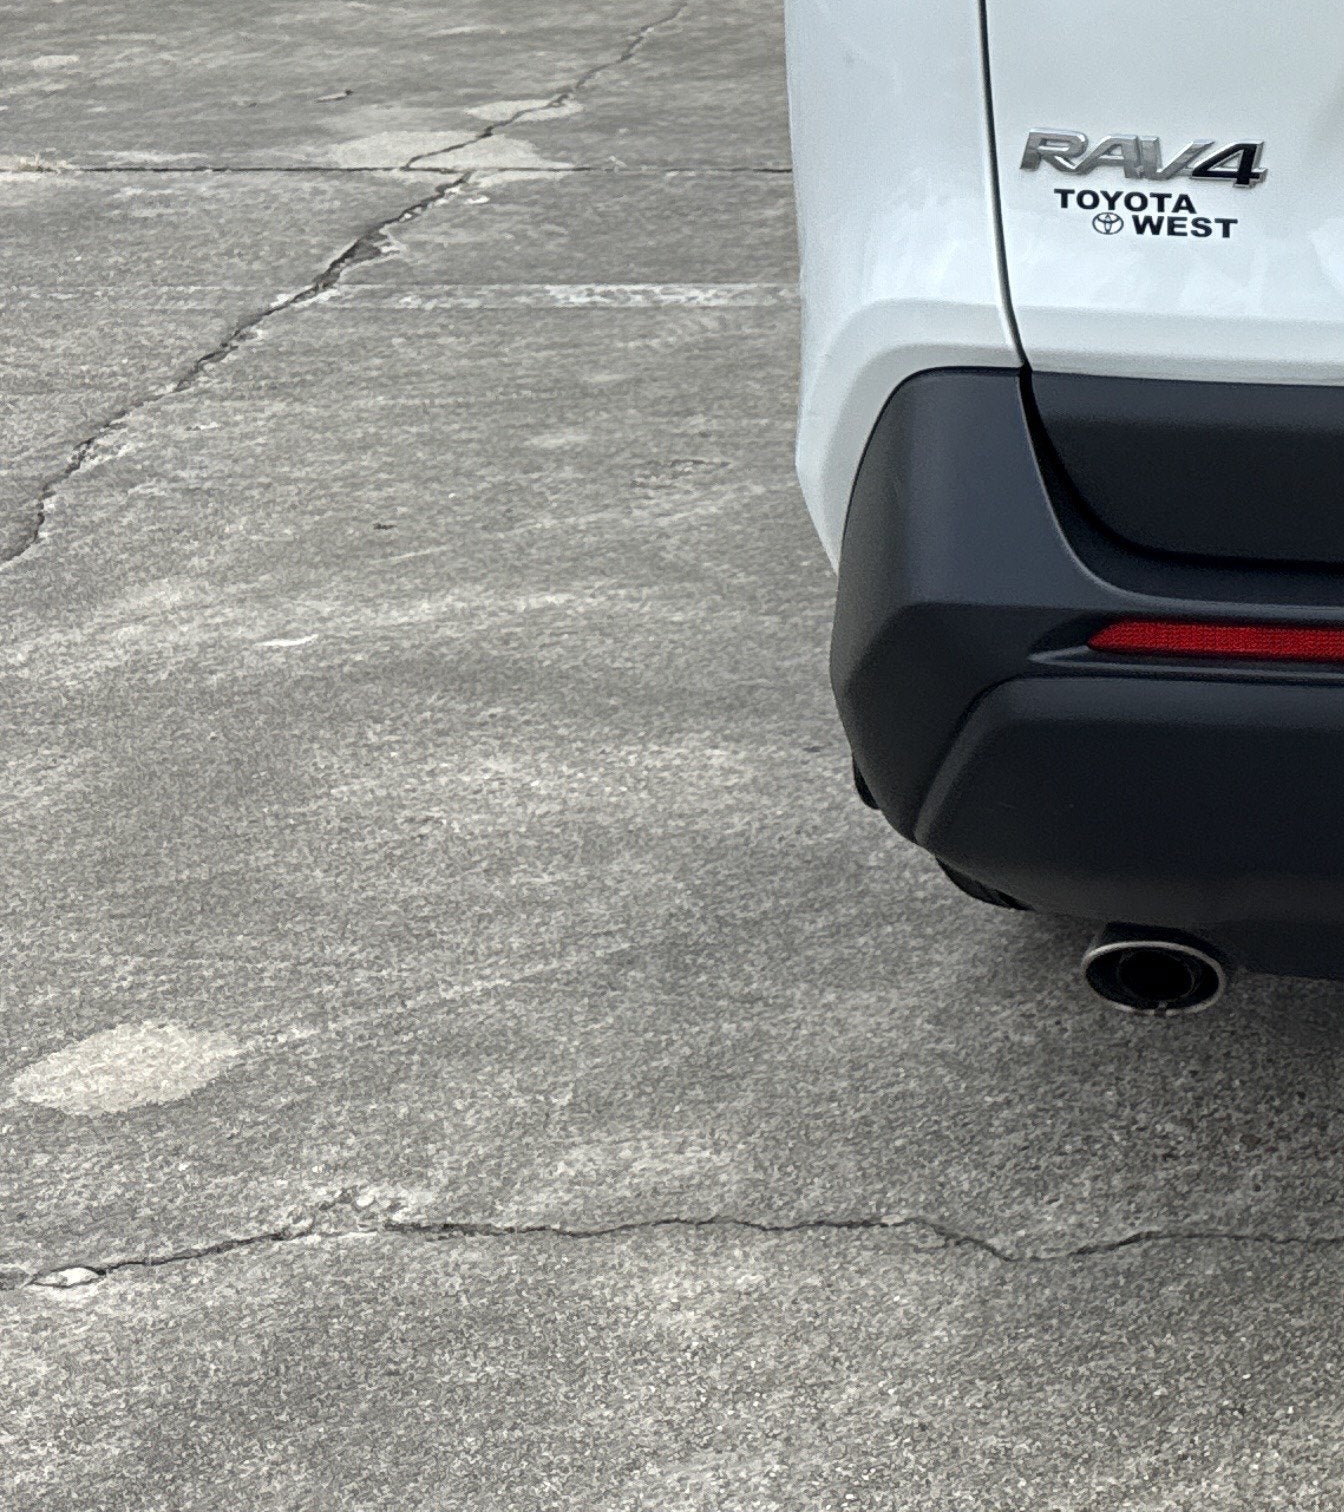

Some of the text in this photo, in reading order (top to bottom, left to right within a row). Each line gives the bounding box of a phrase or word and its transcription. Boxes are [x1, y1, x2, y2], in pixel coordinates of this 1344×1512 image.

[1019, 127, 1268, 188] RAV4
[1053, 188, 1197, 215] TOYOTA
[1131, 214, 1239, 239] WEST
